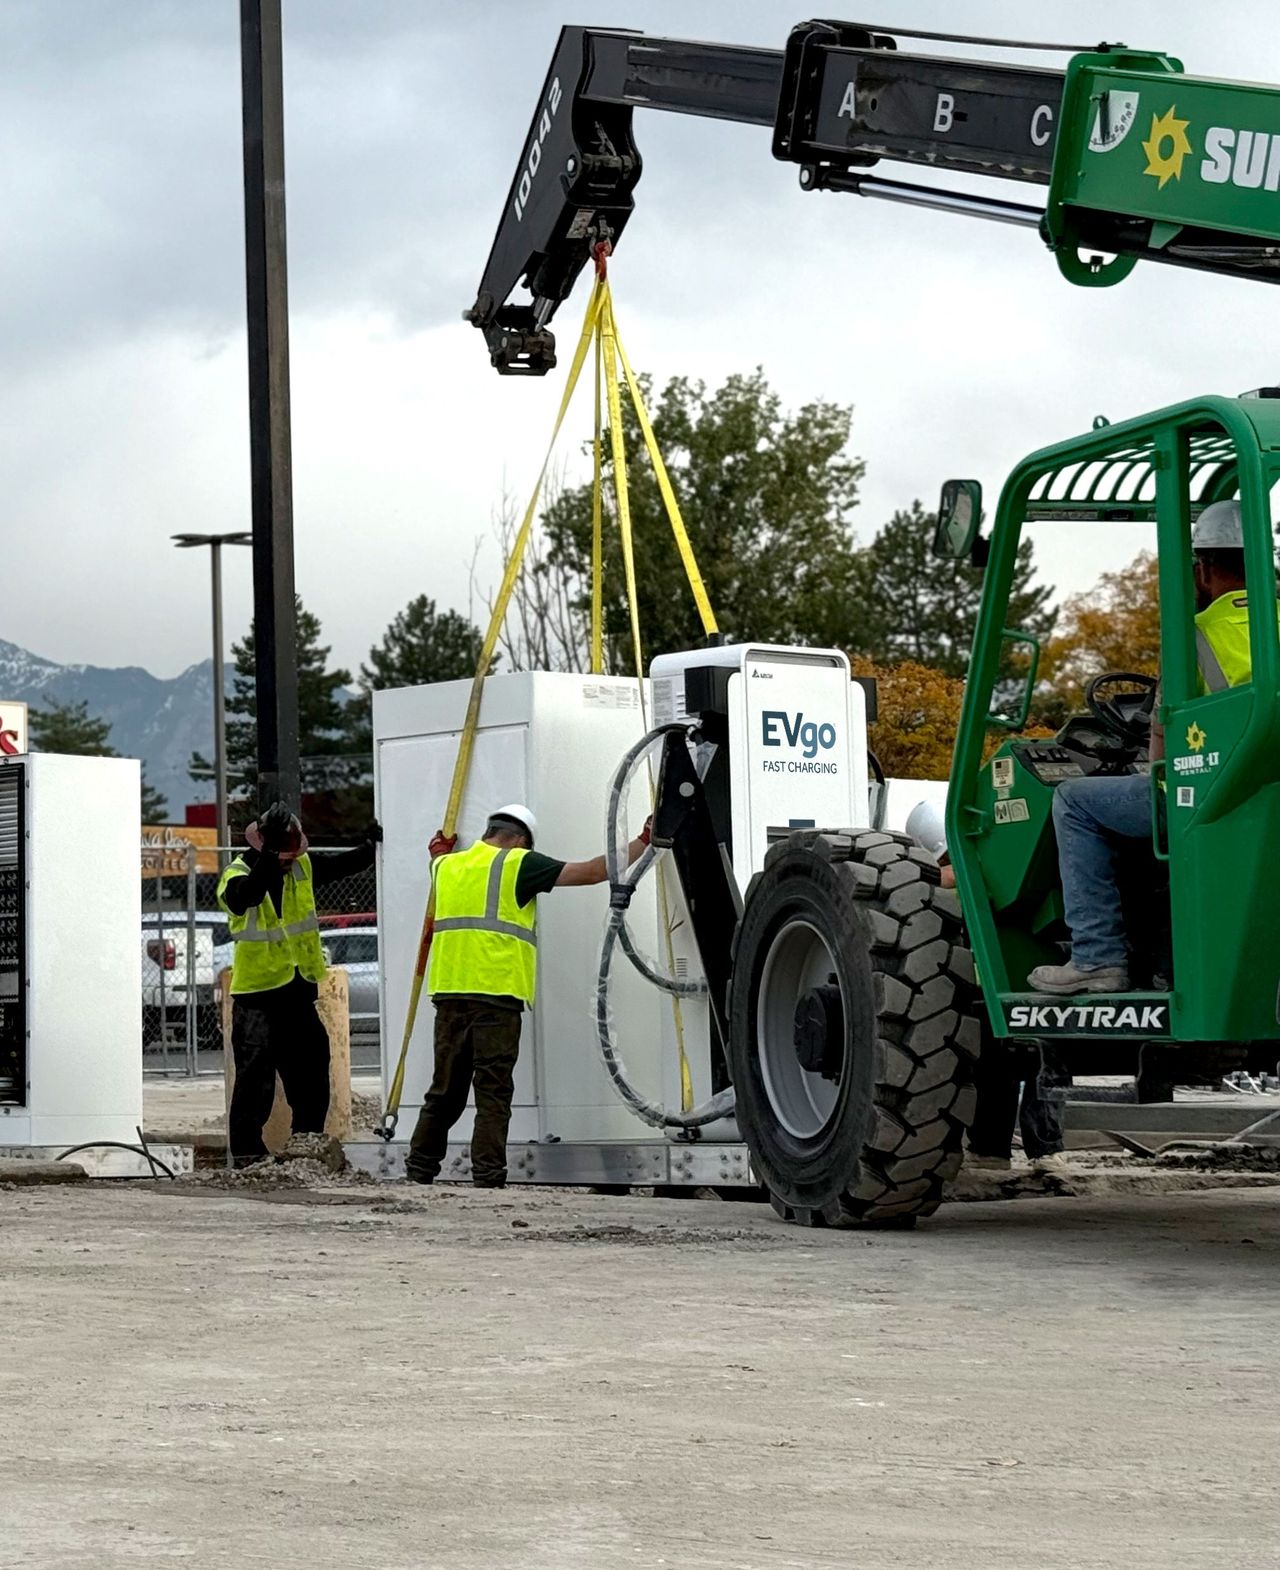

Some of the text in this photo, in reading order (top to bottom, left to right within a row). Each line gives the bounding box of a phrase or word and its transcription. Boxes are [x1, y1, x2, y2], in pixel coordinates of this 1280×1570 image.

[837, 81, 857, 120] A
[933, 93, 954, 133] B
[1030, 104, 1053, 147] C
[514, 77, 562, 222] 10042
[762, 710, 837, 759] EVgo
[763, 760, 837, 775] FAST CHARGING
[1173, 752, 1219, 771] SUNBLT
[1009, 1006, 1166, 1028] SKYTRAK
